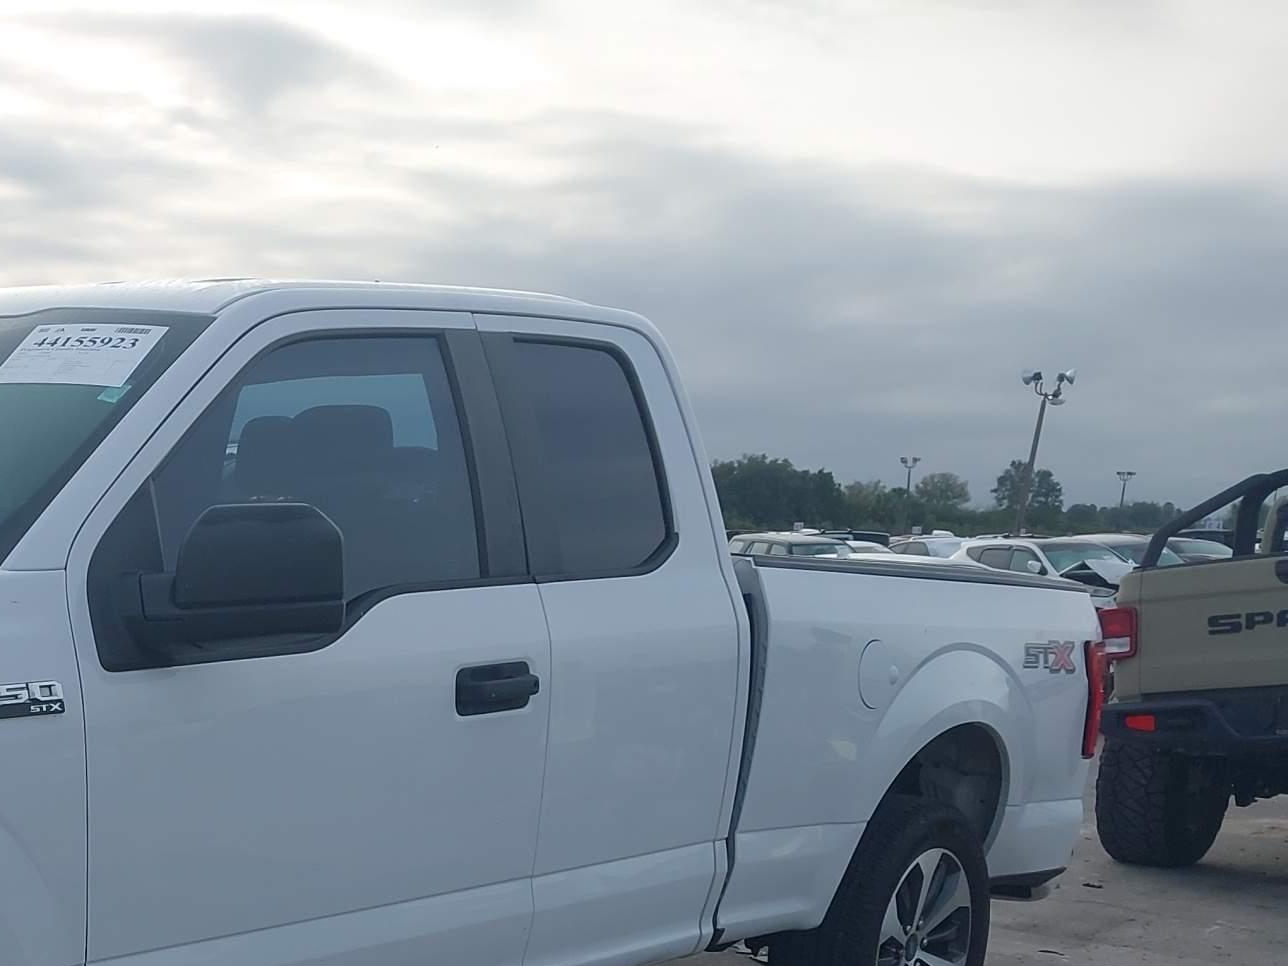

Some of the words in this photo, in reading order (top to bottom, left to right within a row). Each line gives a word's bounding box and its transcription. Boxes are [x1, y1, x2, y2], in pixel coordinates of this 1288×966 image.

[32, 335, 140, 350] 44155923
[1022, 640, 1076, 675] STX
[30, 702, 64, 714] STX
